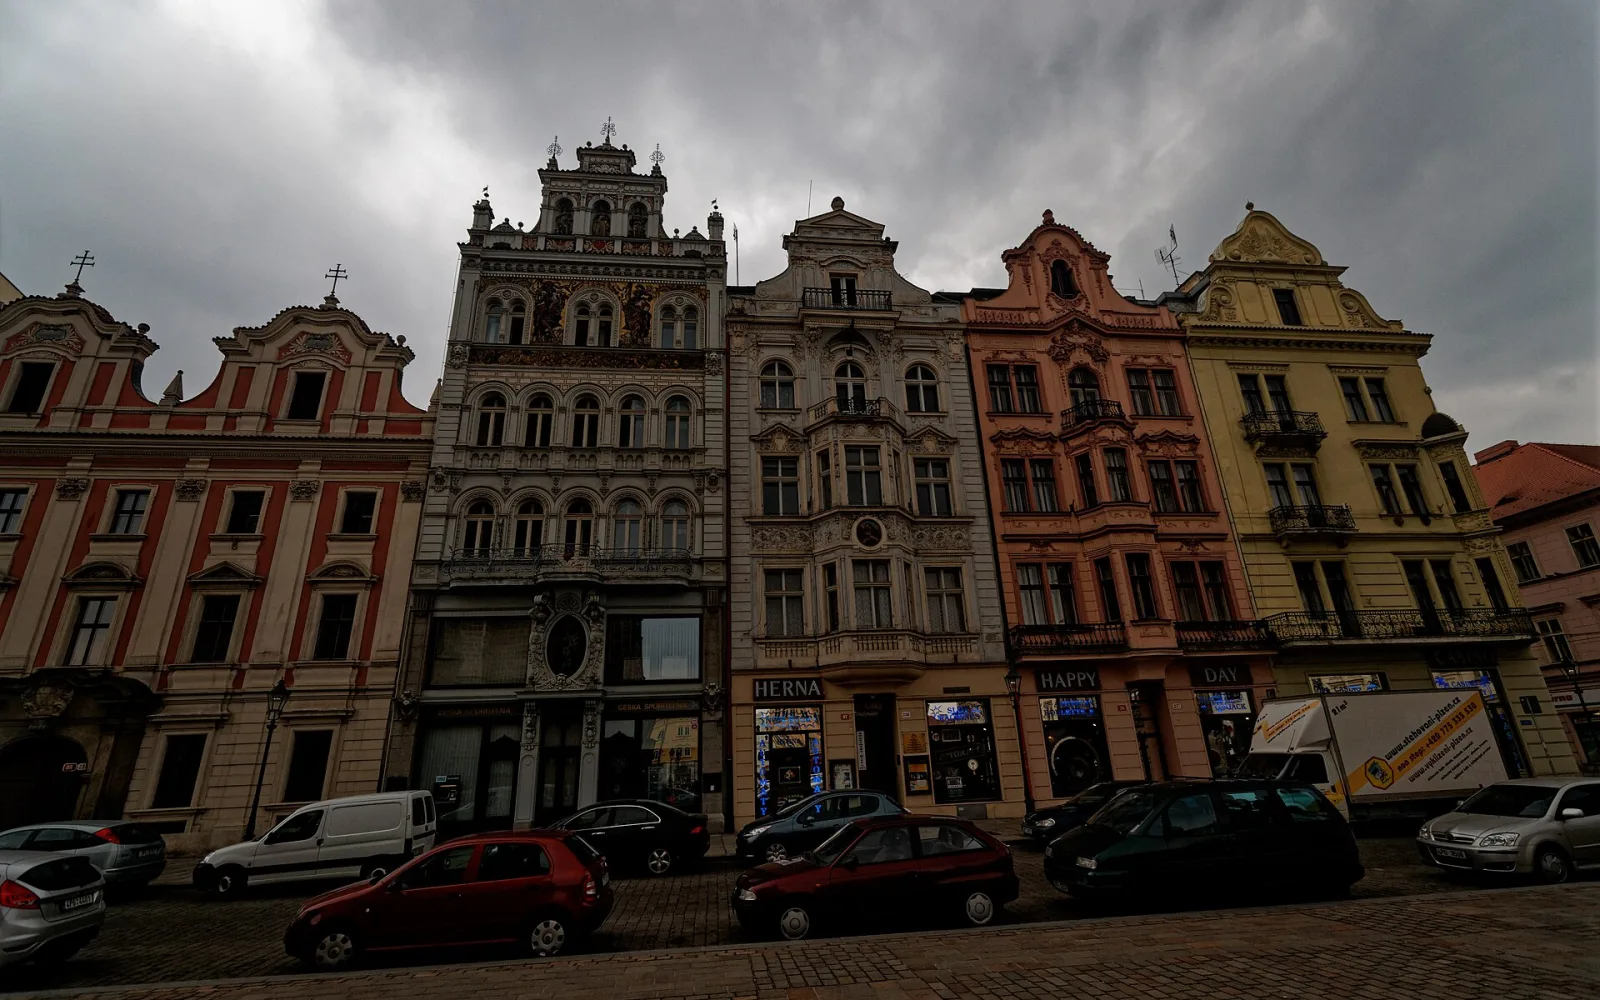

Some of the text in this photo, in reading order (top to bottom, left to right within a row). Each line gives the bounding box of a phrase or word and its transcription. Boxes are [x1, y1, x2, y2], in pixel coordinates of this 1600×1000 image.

[1040, 672, 1096, 689] HAPPY
[1204, 667, 1237, 683] DAY
[755, 680, 821, 697] HERNA
[1397, 702, 1477, 772] non stop: +420 775 335 530
